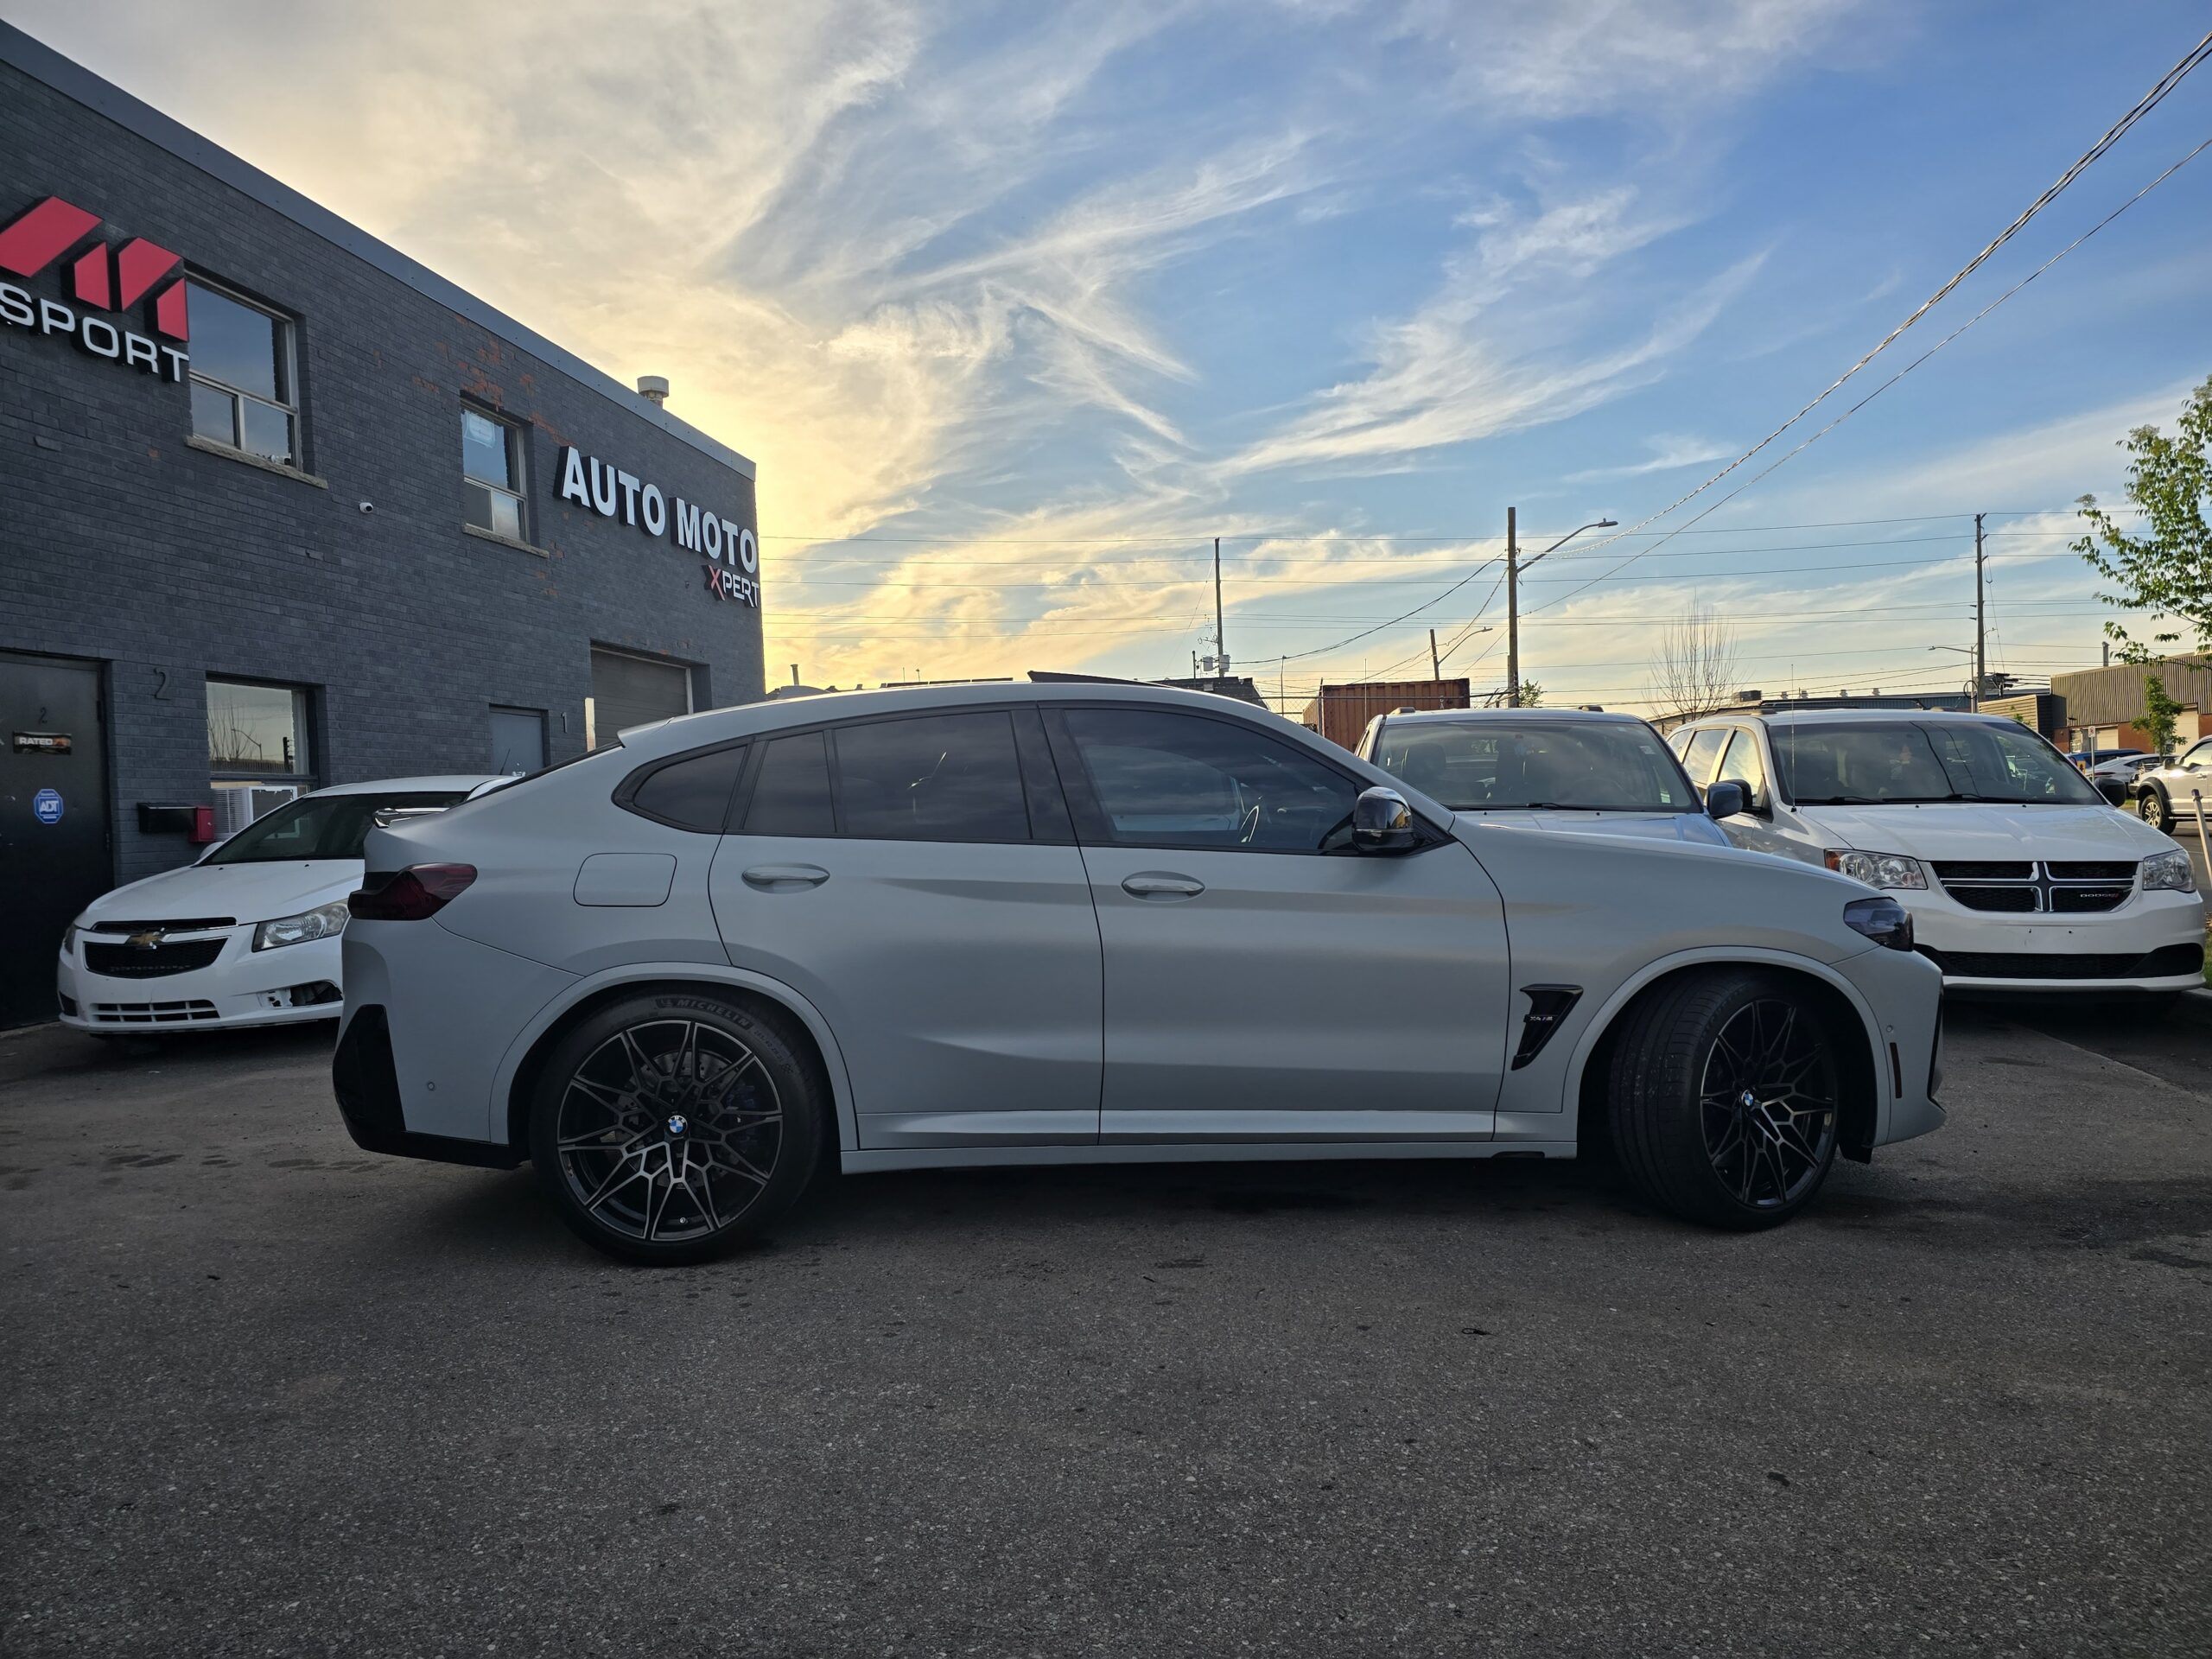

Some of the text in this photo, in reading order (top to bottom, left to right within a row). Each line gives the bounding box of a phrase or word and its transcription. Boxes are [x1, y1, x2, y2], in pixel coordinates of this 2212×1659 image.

[0, 282, 190, 383] SPORT
[562, 446, 758, 574] AUTO MOTO
[707, 564, 760, 608] XPERT
[152, 667, 171, 701] 2
[19, 736, 54, 747] RATED
[40, 800, 59, 812] ADT
[677, 999, 749, 1027] MICHELIN
